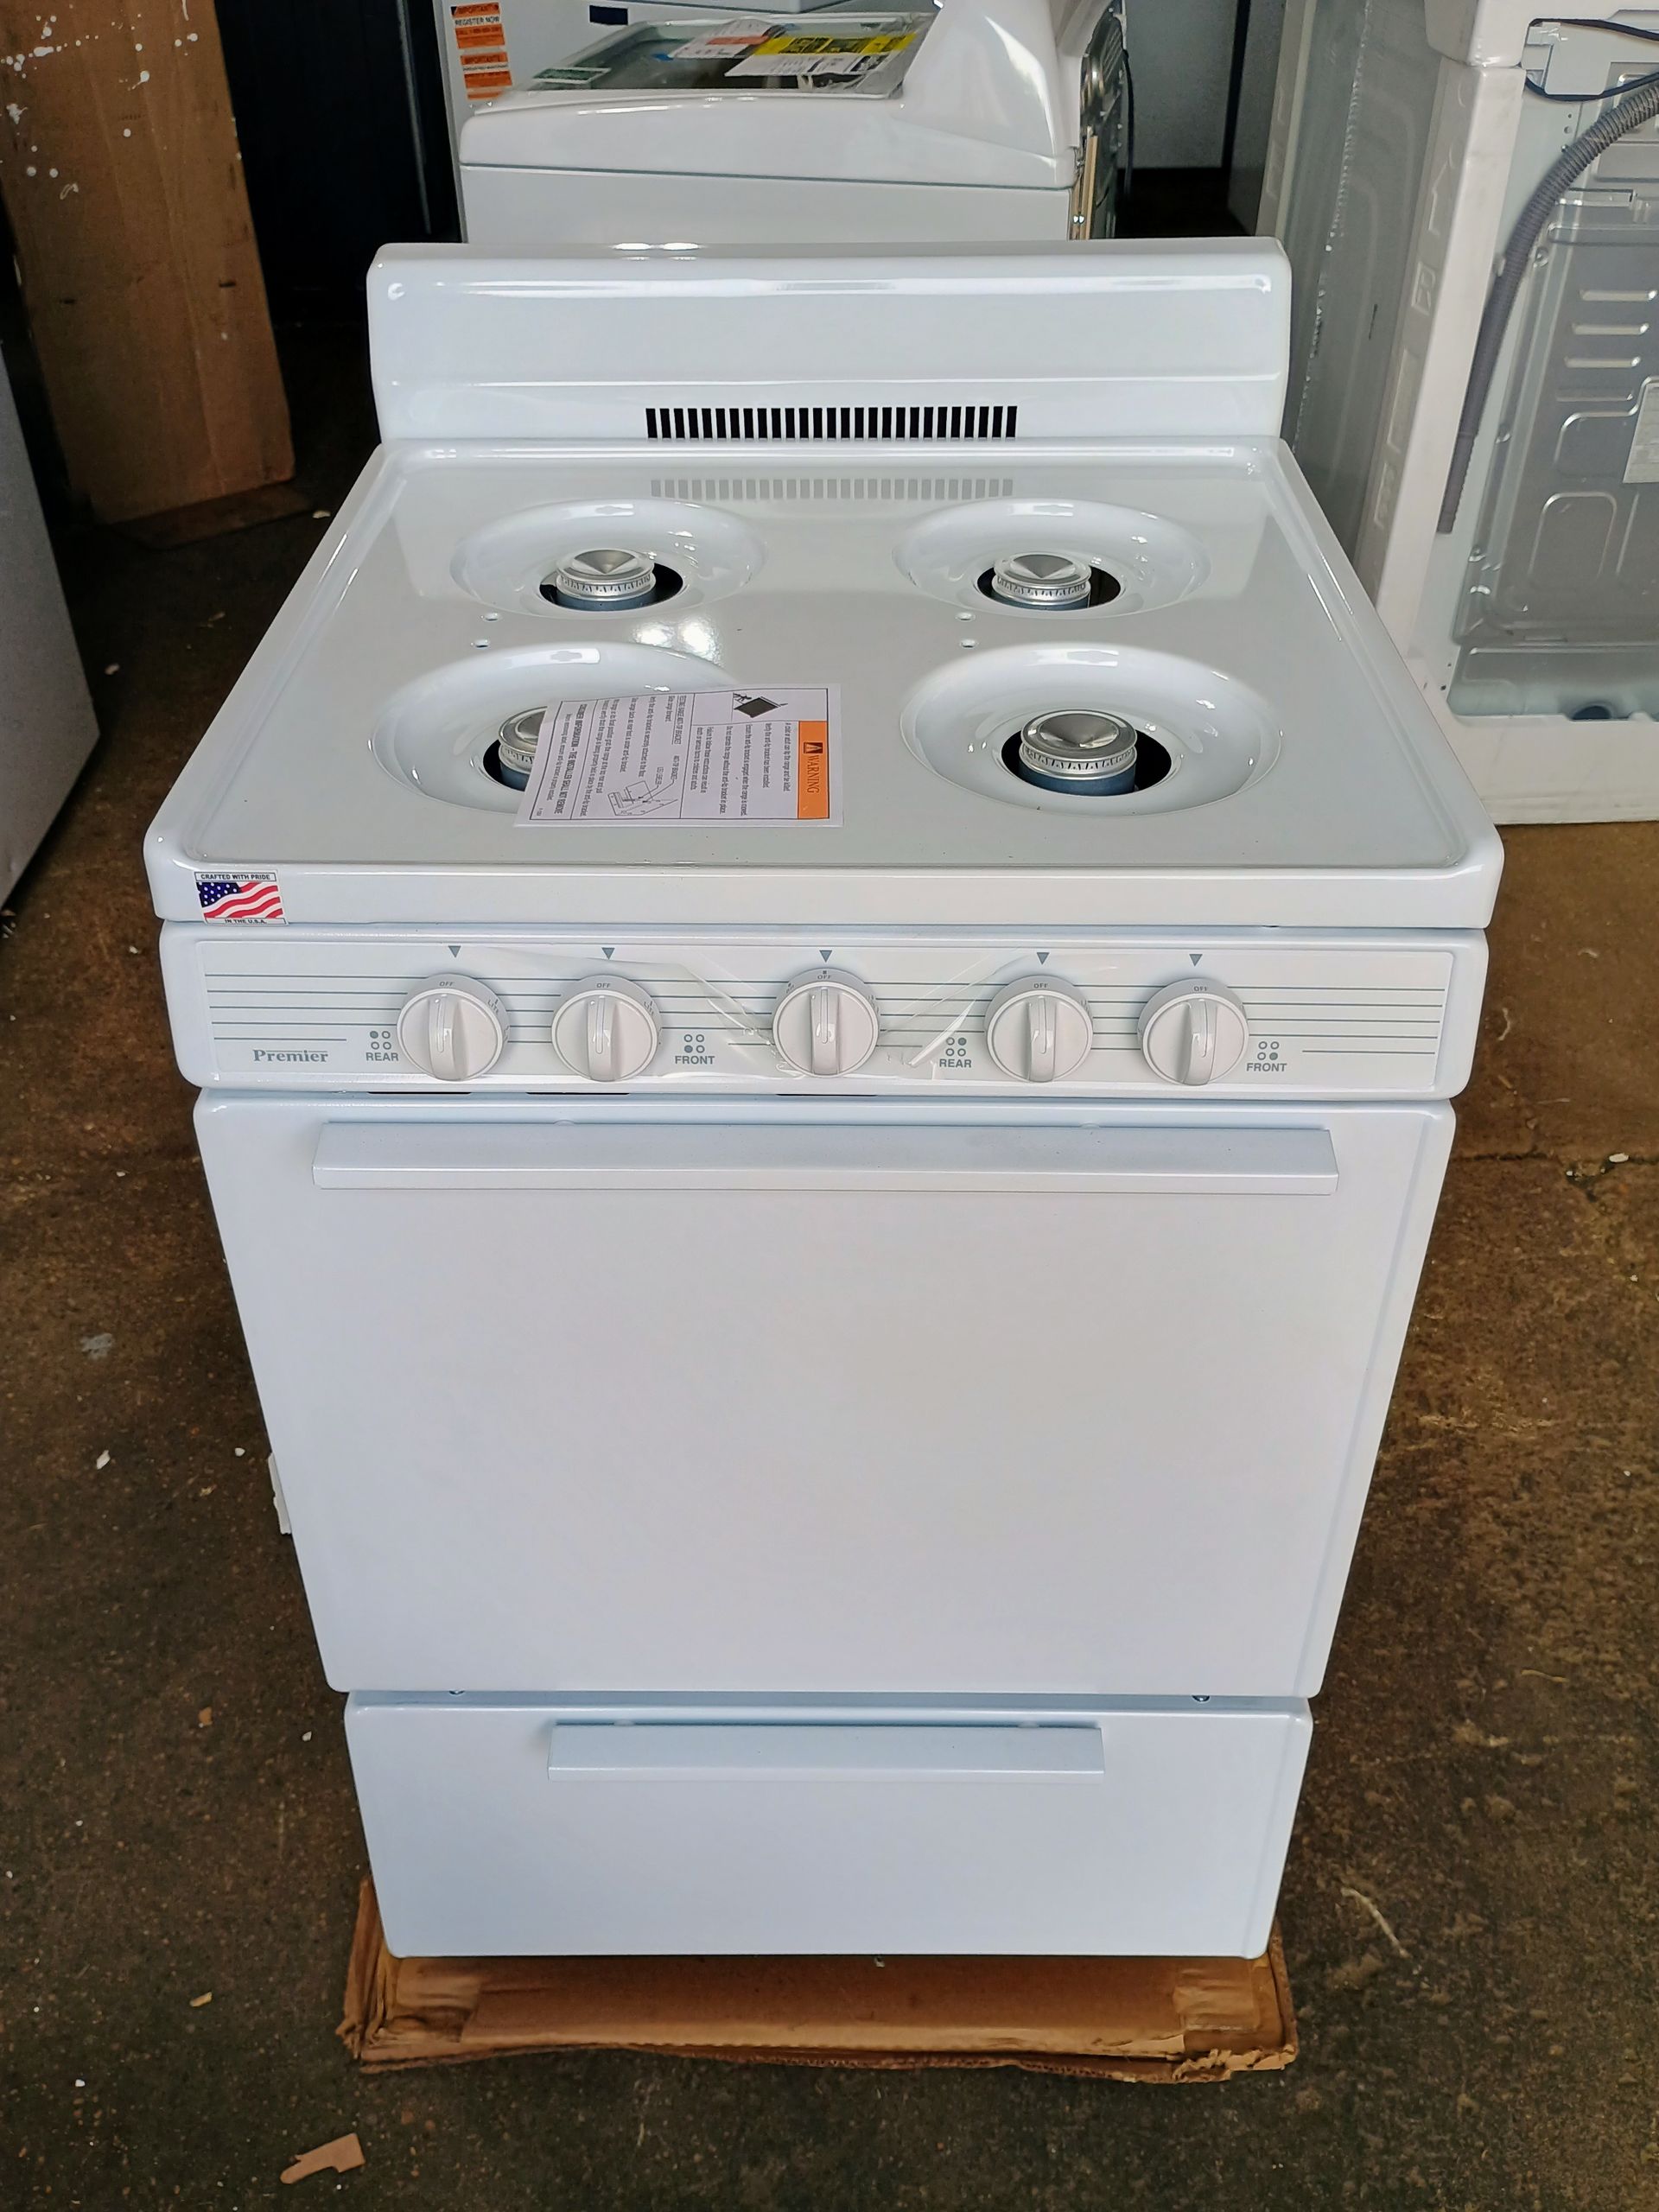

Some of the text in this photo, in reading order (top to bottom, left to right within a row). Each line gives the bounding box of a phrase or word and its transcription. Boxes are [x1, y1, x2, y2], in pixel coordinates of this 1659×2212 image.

[807, 754, 819, 793] WARNING
[252, 1049, 328, 1062] Premier
[365, 1052, 398, 1062] REAR
[675, 1055, 715, 1065] FRONT
[939, 1058, 971, 1068] REAR
[1246, 1063, 1287, 1071] FRONT
